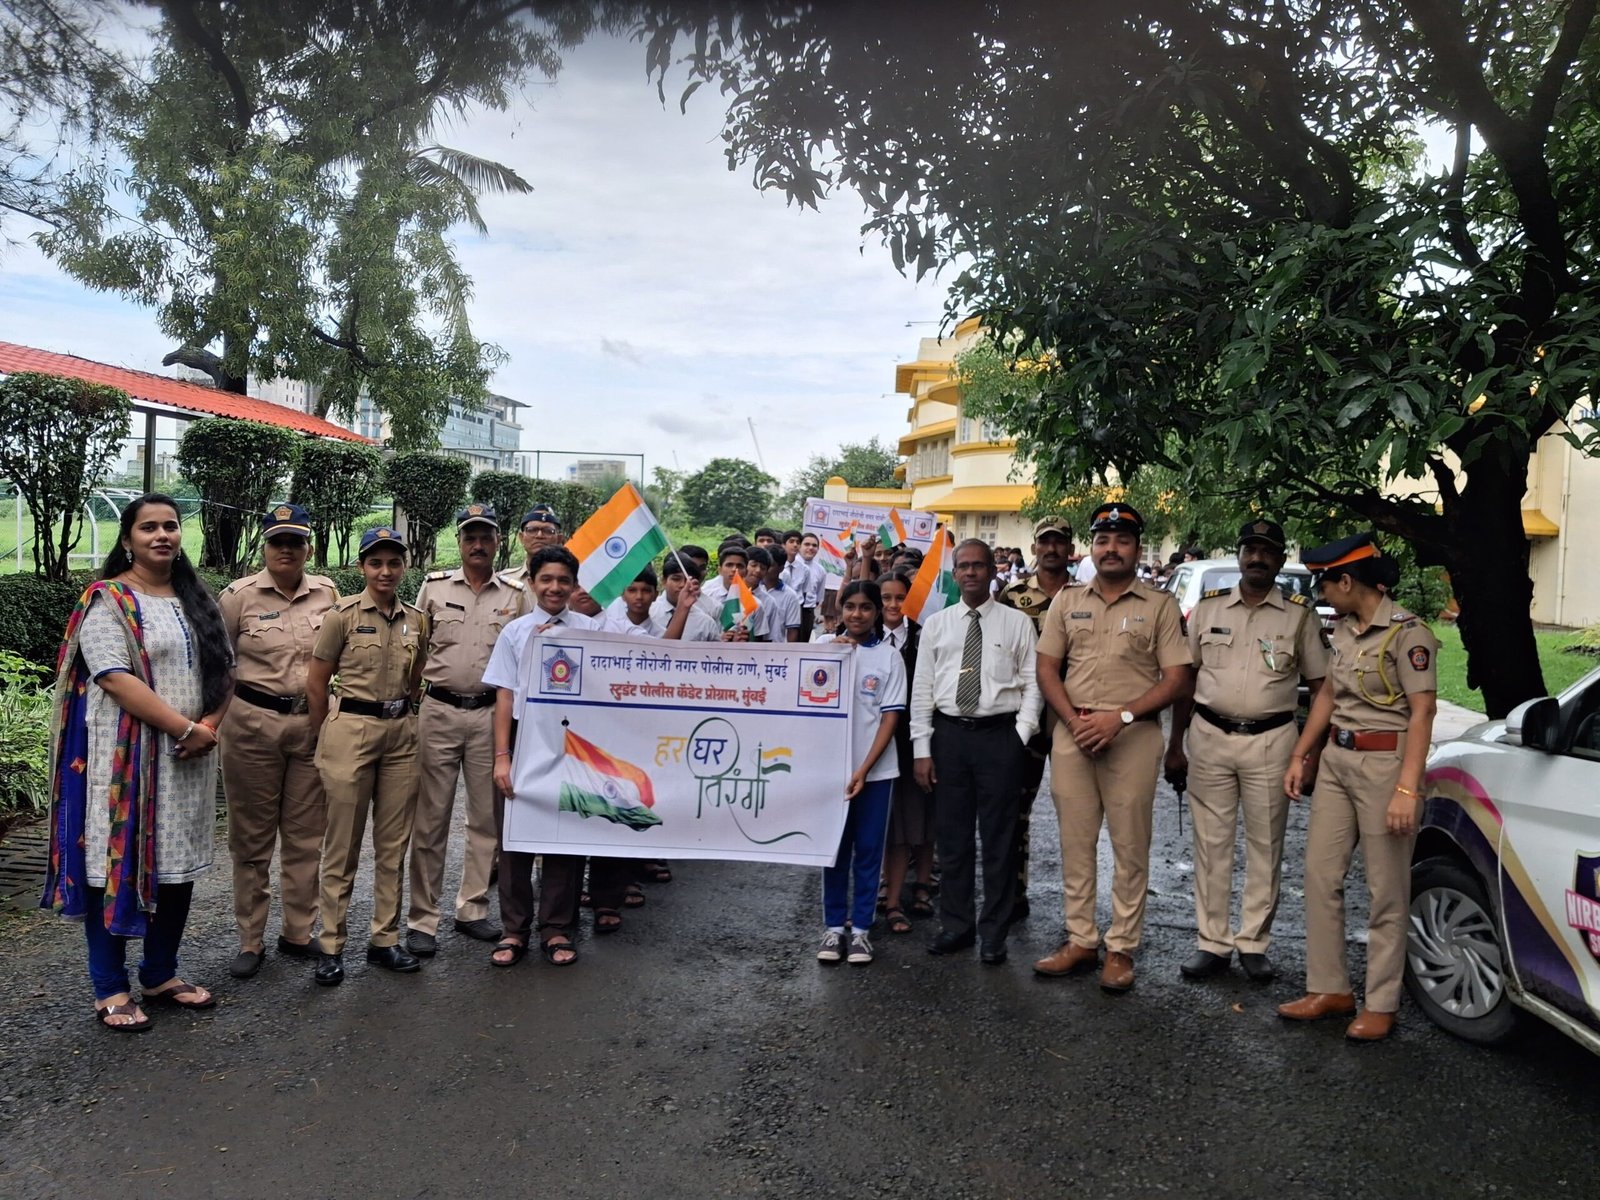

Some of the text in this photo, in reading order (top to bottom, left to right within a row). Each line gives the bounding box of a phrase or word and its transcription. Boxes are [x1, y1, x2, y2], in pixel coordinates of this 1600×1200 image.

[590, 650, 633, 672] दादाभाई
[635, 650, 672, 672] नौरोजी
[675, 659, 698, 674] नगर
[701, 655, 734, 675] पोलीस
[764, 657, 789, 682] मुंबई
[639, 681, 675, 698] पोलीस
[742, 686, 767, 707] मुंबई
[654, 736, 728, 768] हर घर
